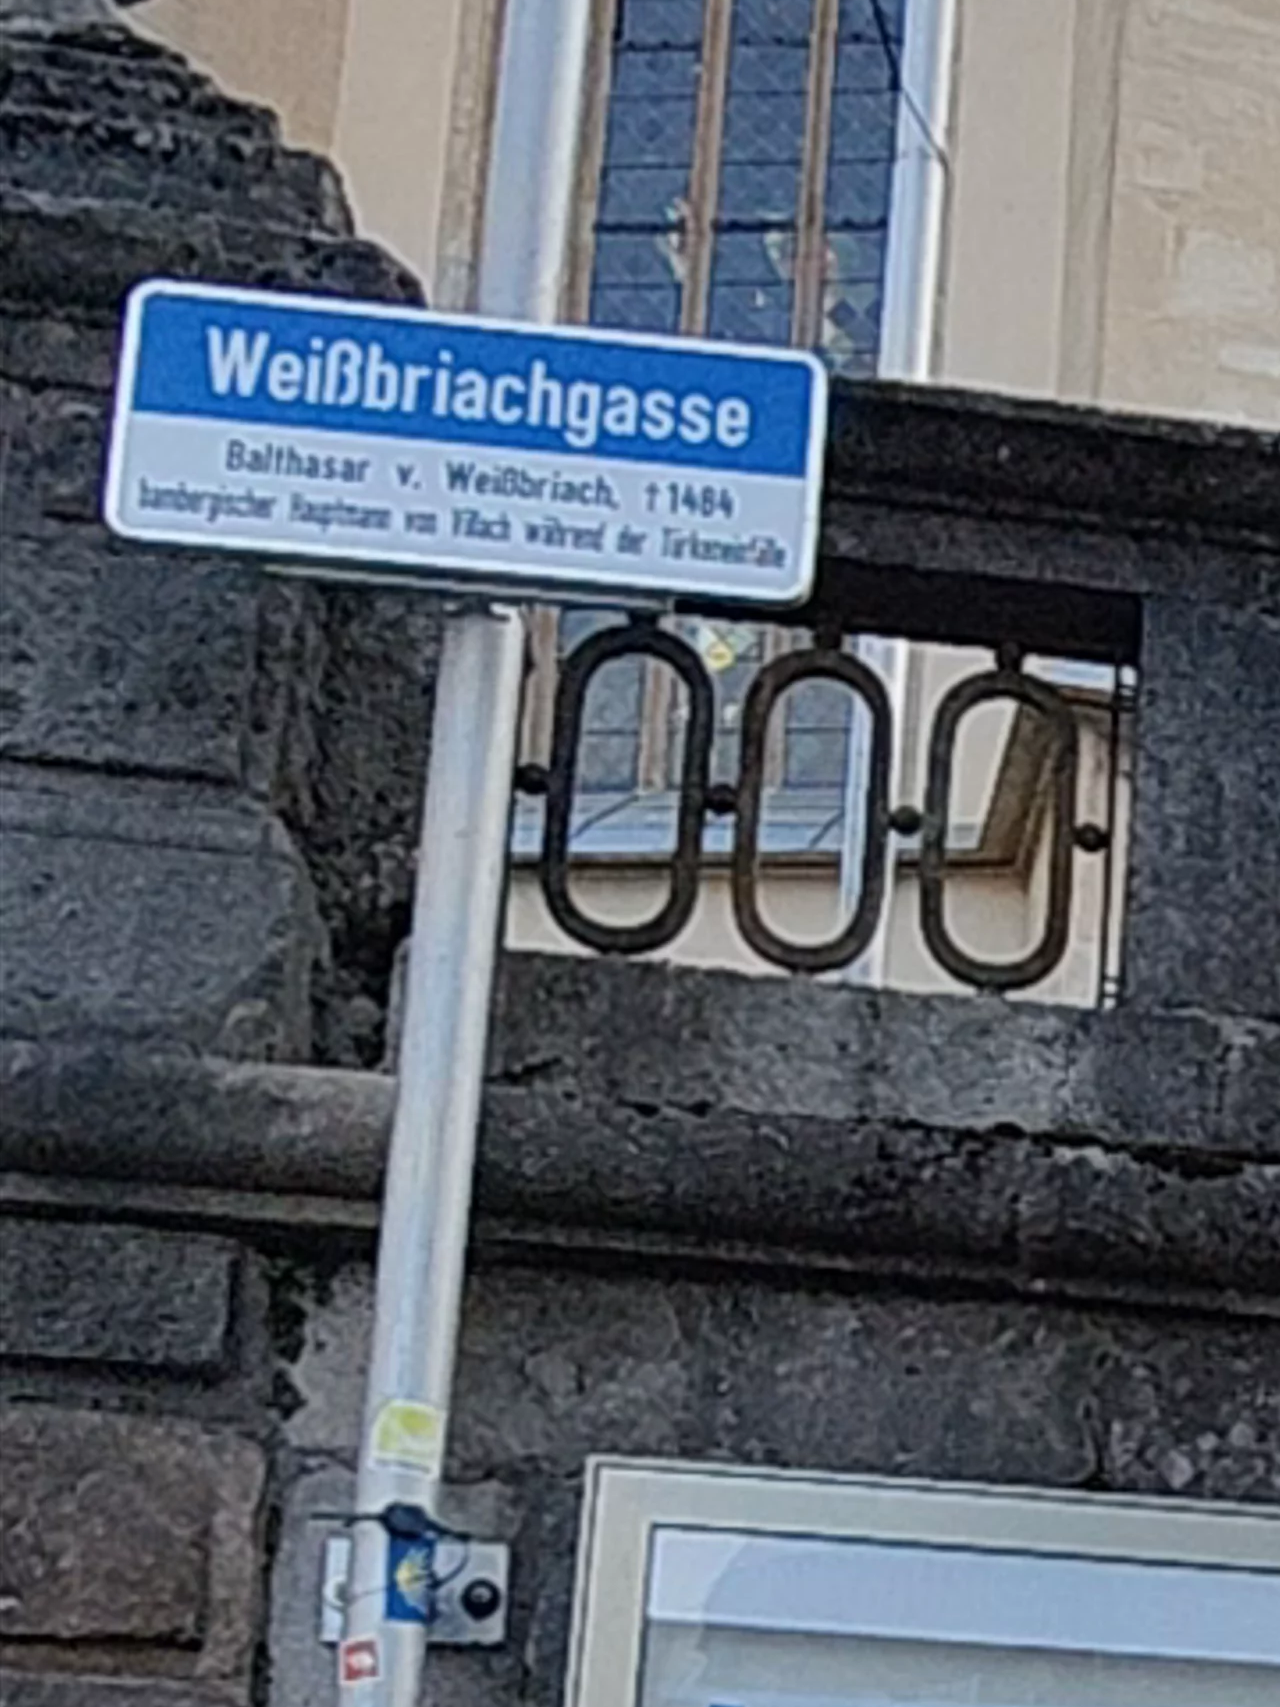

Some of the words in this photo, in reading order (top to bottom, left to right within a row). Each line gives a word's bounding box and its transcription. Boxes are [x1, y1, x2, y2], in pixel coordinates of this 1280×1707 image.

[206, 325, 751, 448] Weißbriachgasse
[225, 439, 370, 482] Balthasar
[396, 461, 422, 490] v.
[288, 491, 392, 535] Hauptmann
[404, 510, 438, 534] von
[452, 507, 512, 542] Villach
[616, 524, 648, 555] der
